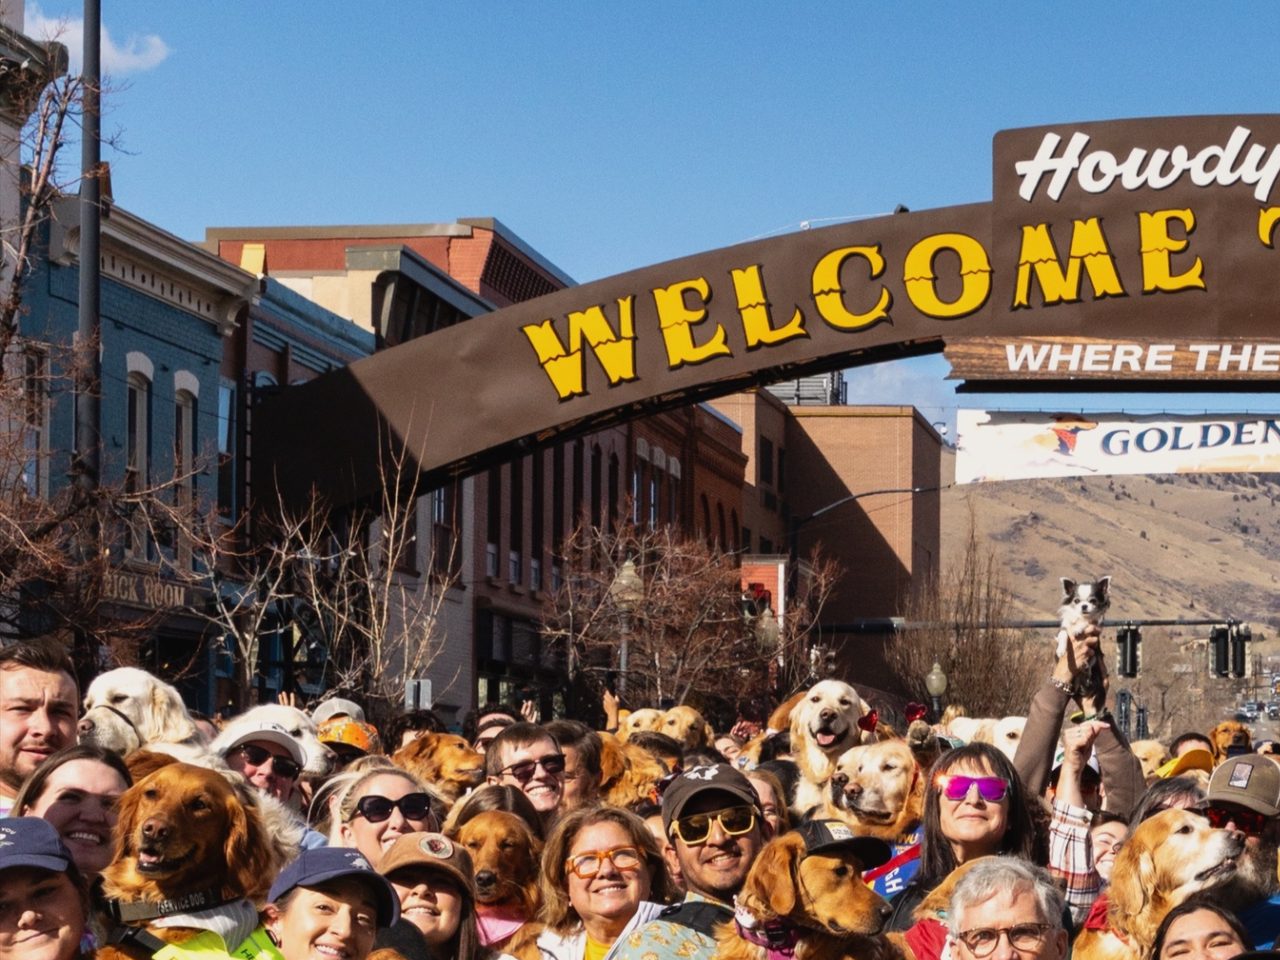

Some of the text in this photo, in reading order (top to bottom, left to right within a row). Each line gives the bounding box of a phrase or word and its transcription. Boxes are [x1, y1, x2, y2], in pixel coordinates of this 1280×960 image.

[520, 207, 1206, 401] WELCOME
[1005, 344, 1176, 372] WHERE
[189, 891, 206, 908] DOG
